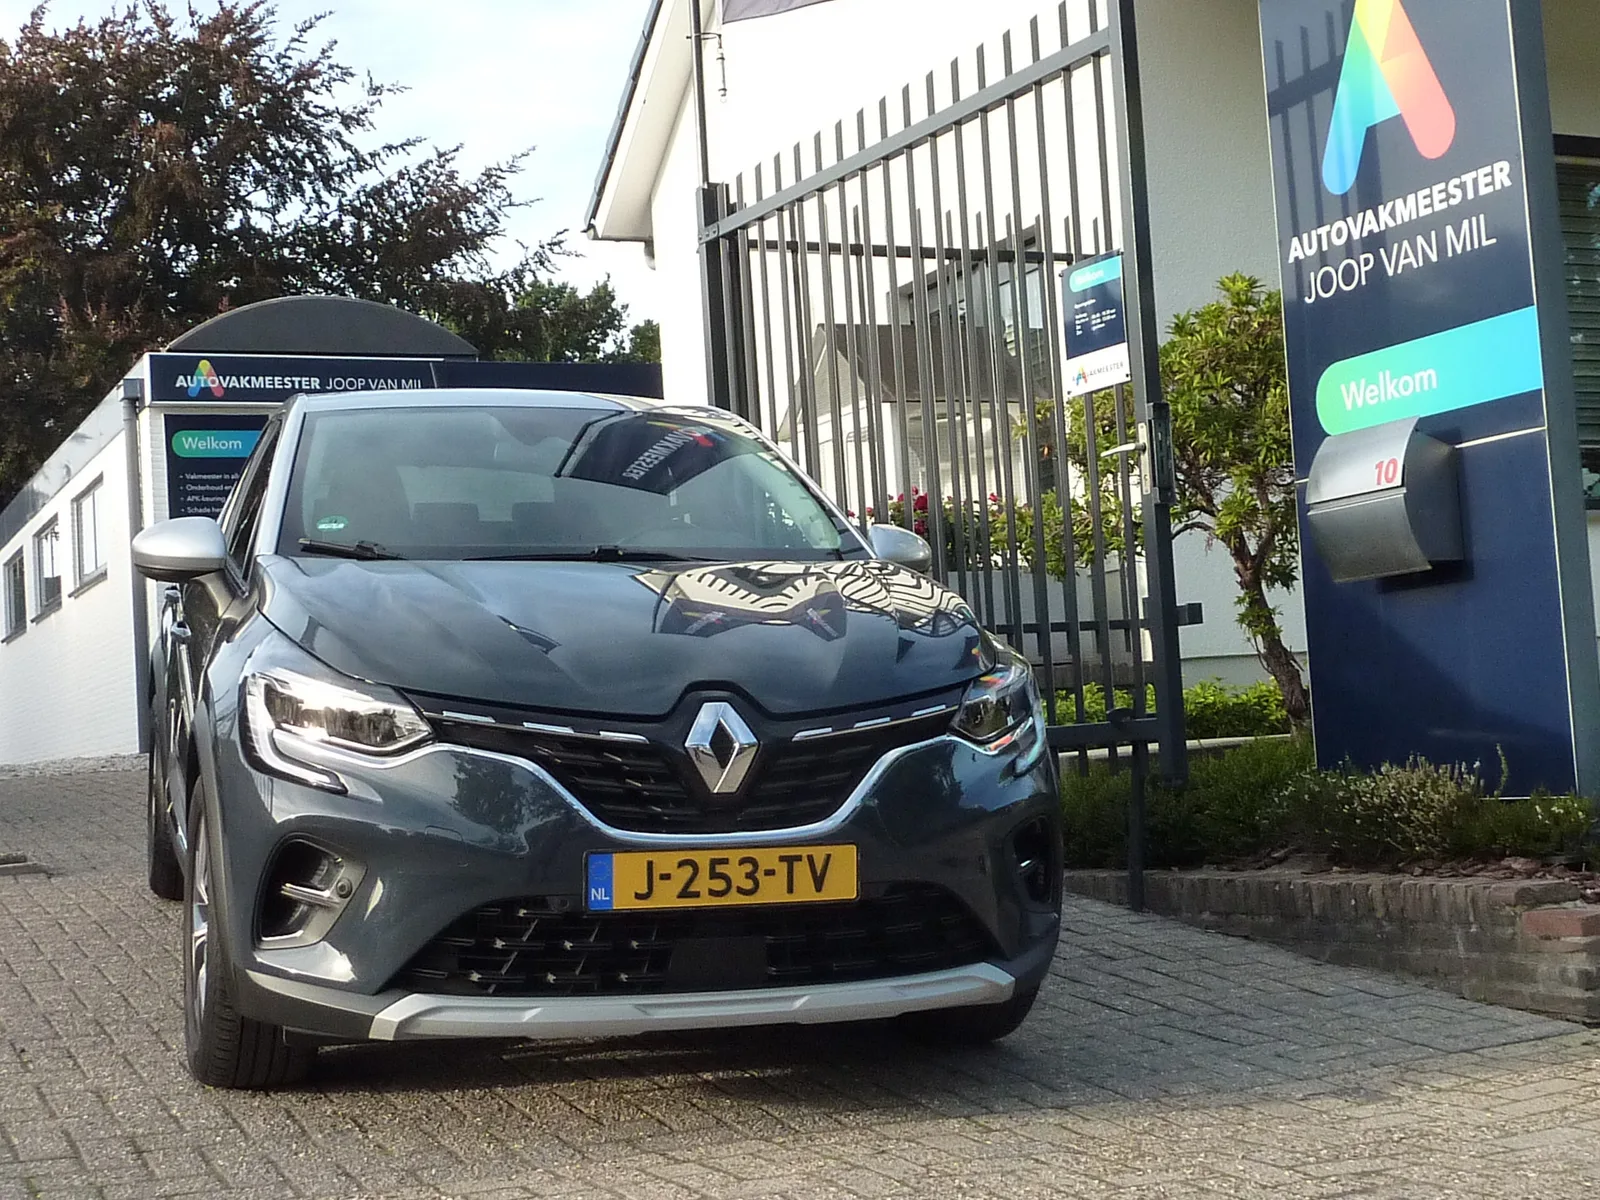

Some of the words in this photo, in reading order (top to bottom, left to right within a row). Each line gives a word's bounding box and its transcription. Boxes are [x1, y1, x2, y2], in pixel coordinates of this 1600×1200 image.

[1288, 160, 1512, 263] AUTOVAKMEESTER
[1304, 253, 1375, 304] JOOP
[1380, 230, 1438, 277] VAN
[1445, 213, 1497, 257] MIL
[175, 375, 321, 390] AUTOVAKMEESTER
[326, 377, 366, 390] JOOP
[368, 379, 398, 390] VAN
[1340, 368, 1437, 411] Welkom
[182, 436, 242, 450] Welkom
[1375, 458, 1398, 486] 10
[186, 495, 226, 503] APK-keuring
[187, 506, 211, 514] Schade
[634, 854, 832, 901] J-253-TV
[590, 889, 610, 902] NL
